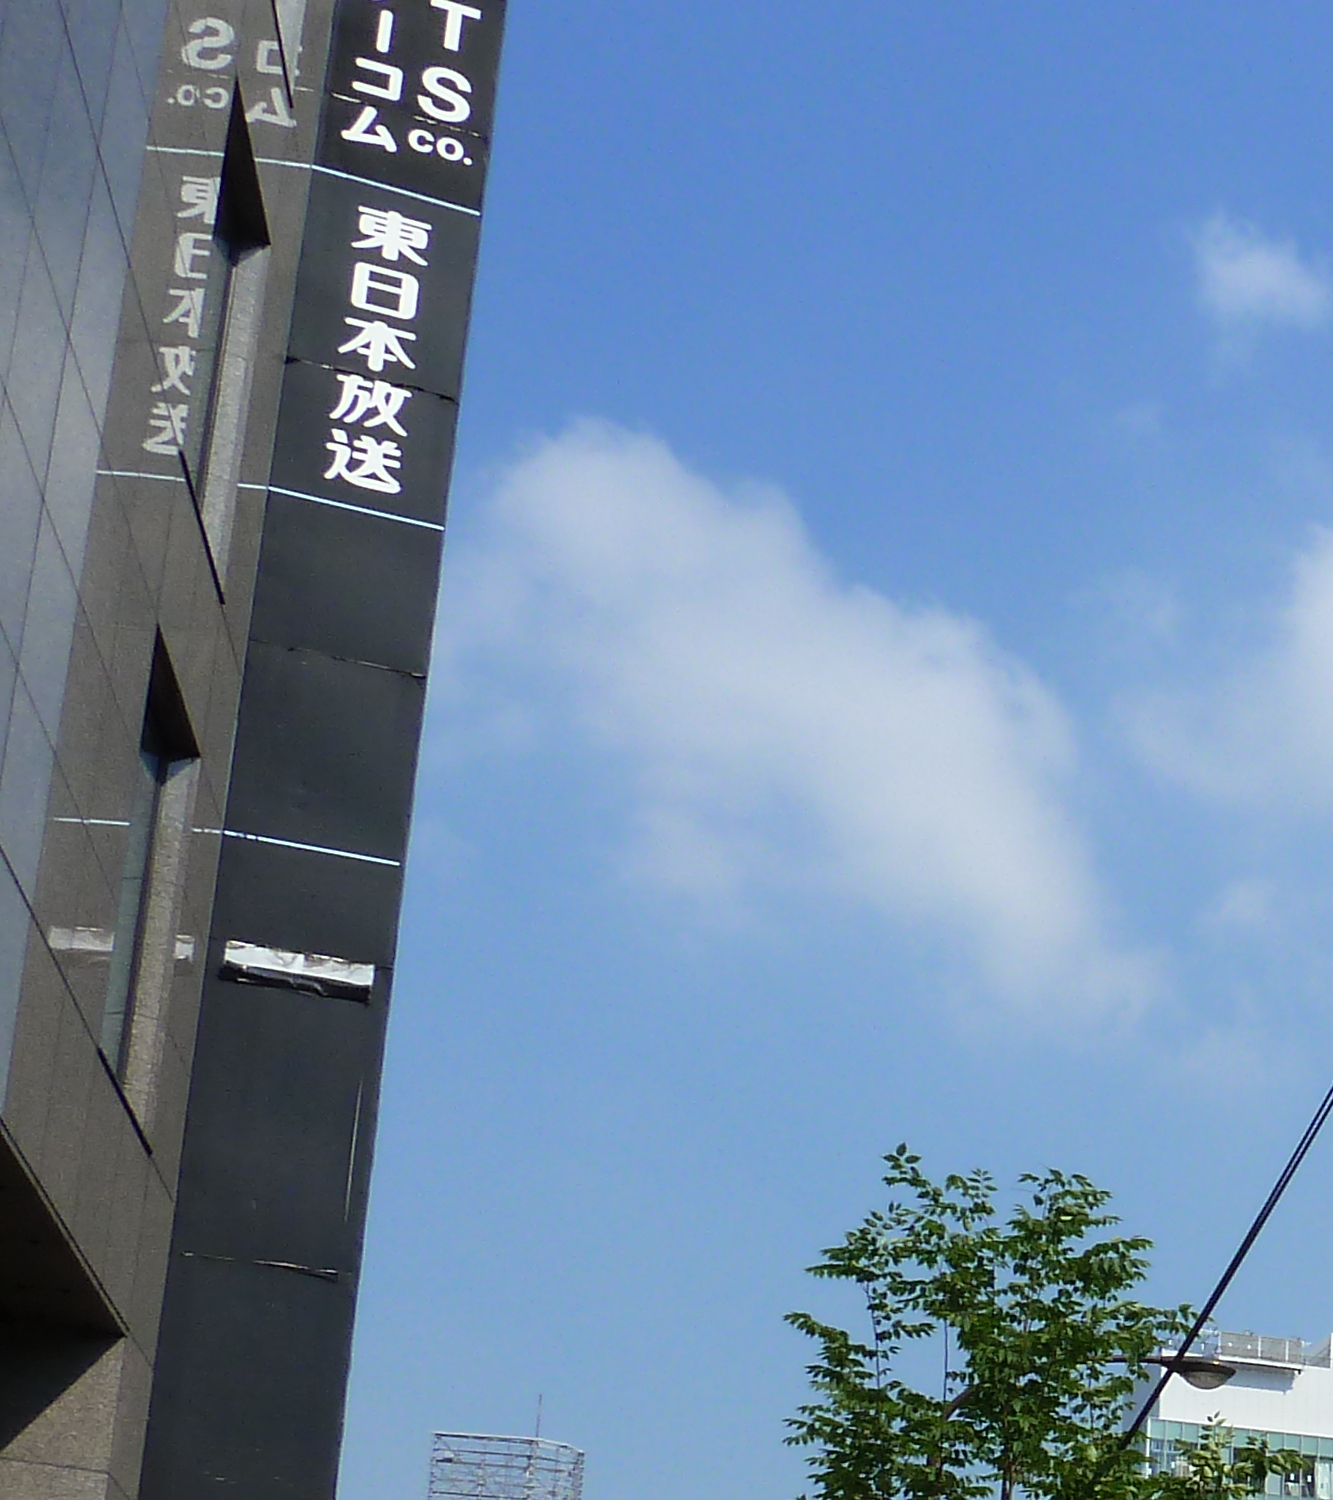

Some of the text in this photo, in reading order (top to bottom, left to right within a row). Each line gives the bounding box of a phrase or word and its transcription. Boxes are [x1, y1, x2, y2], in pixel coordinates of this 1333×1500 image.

[324, 205, 432, 494] 東日本放送
